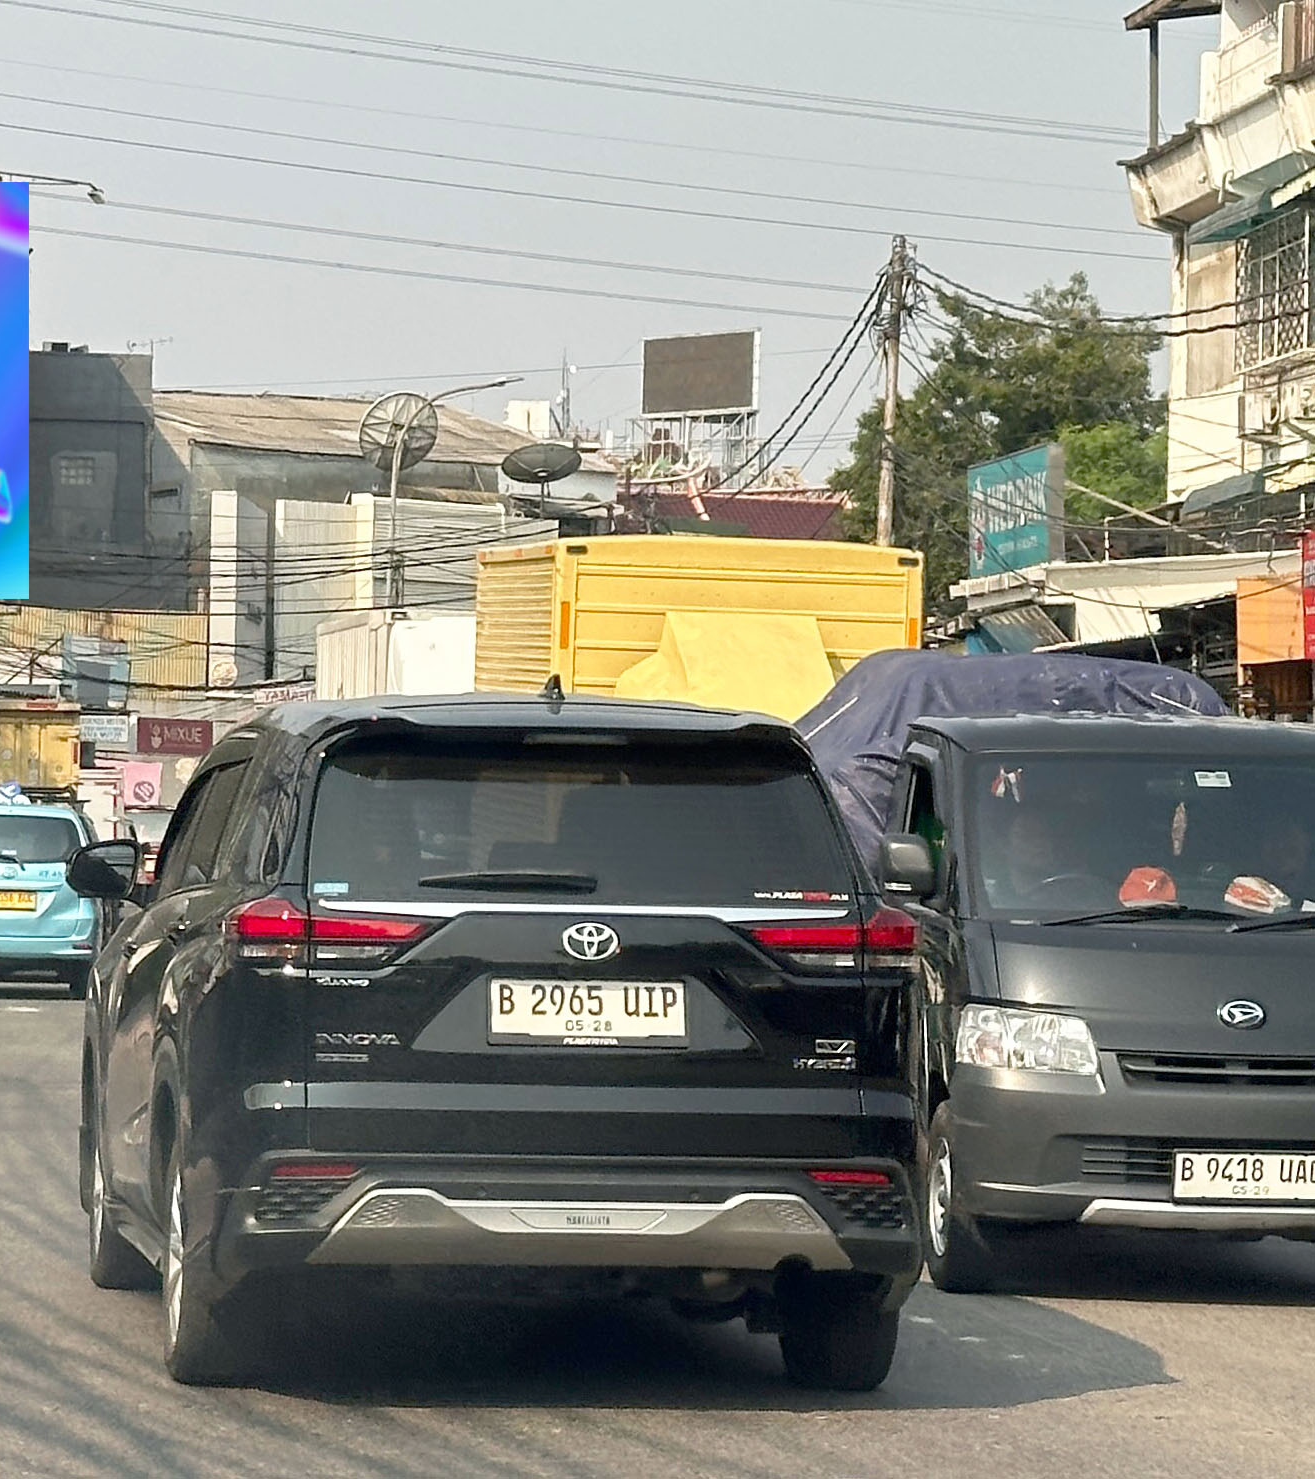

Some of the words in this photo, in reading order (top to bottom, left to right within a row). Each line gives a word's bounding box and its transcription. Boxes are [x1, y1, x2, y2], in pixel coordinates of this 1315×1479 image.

[163, 728, 203, 743] MIXUE
[499, 985, 515, 1015] B
[531, 984, 603, 1016] 2965
[624, 986, 678, 1018] UIP
[315, 1033, 401, 1045] INNOVA
[1181, 1157, 1194, 1181] B
[1207, 1158, 1264, 1182] 9418
